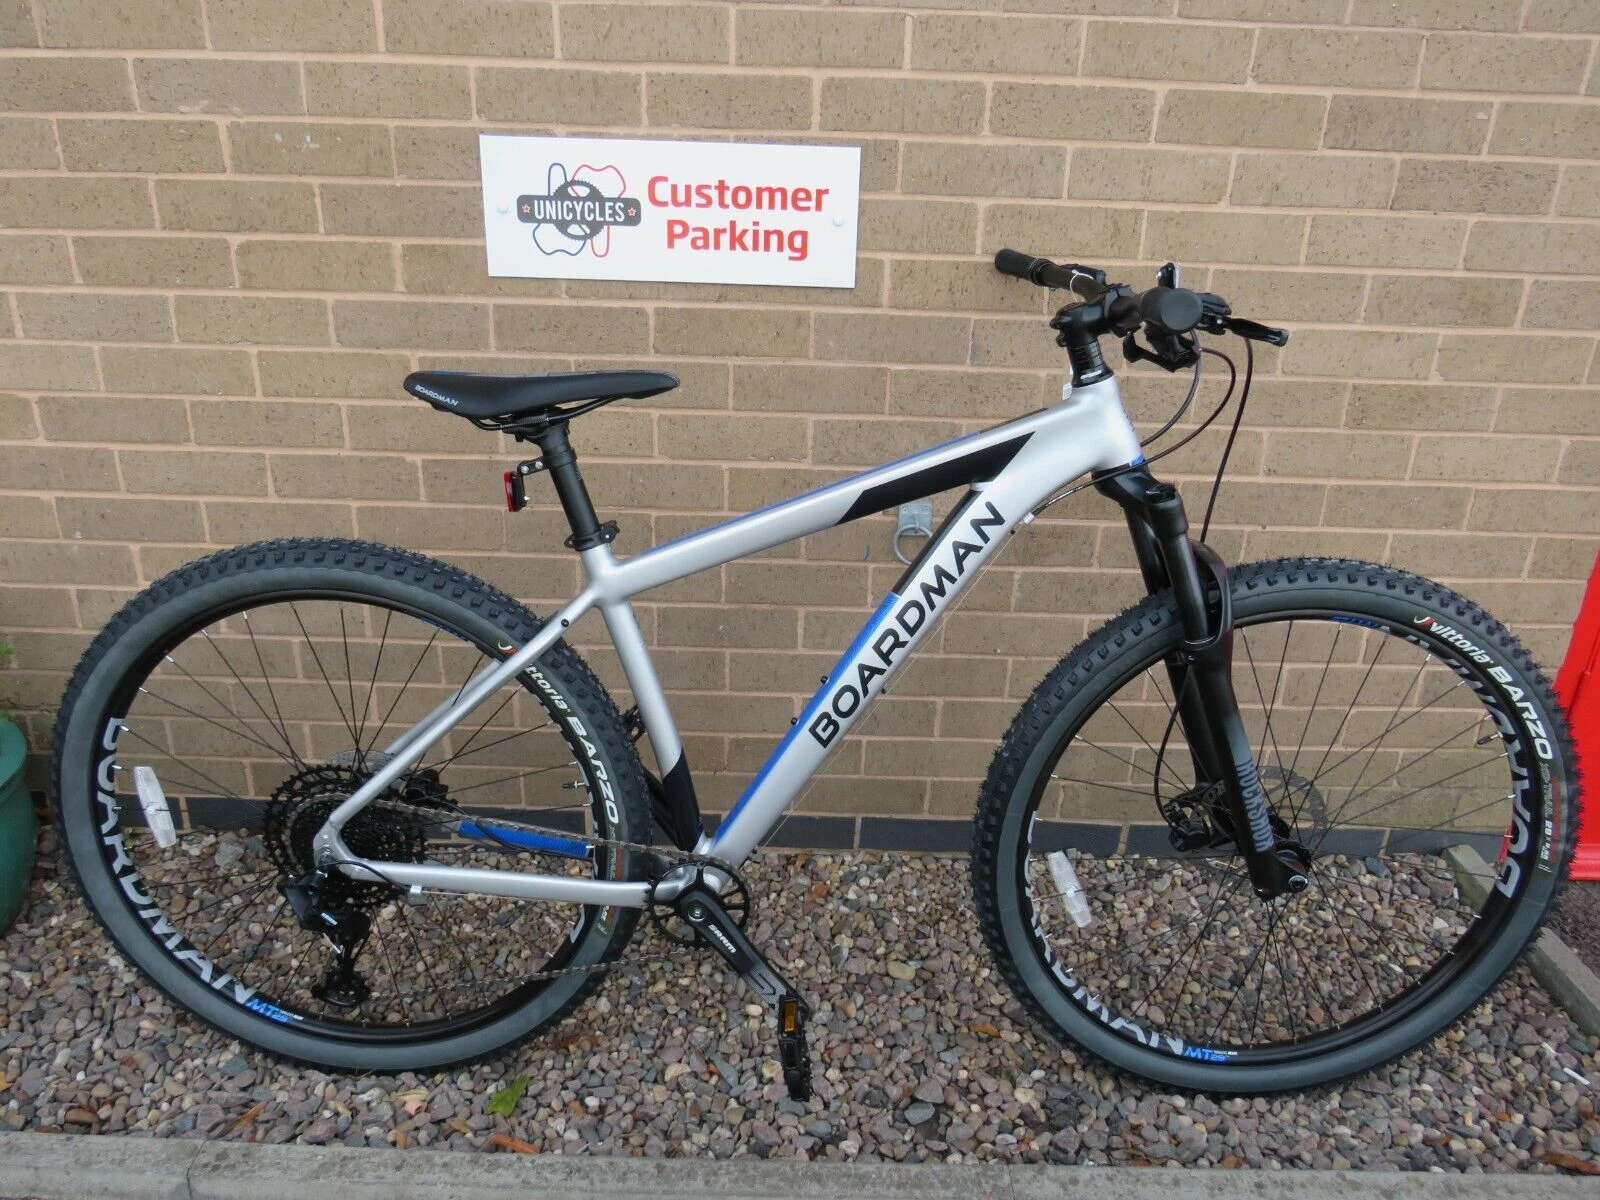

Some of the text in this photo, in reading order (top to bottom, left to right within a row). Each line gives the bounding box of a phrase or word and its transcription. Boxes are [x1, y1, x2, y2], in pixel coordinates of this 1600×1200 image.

[534, 199, 625, 223] UNICYCLES
[647, 175, 830, 212] Customer
[666, 219, 809, 261] Parking
[414, 384, 459, 406] BOARDMAN
[808, 501, 1006, 749] BOARDMAN
[1429, 621, 1490, 664] vittoria
[1487, 665, 1553, 760] BARZO
[525, 664, 619, 824] ttoria BARZO
[708, 924, 737, 954] SRAM
